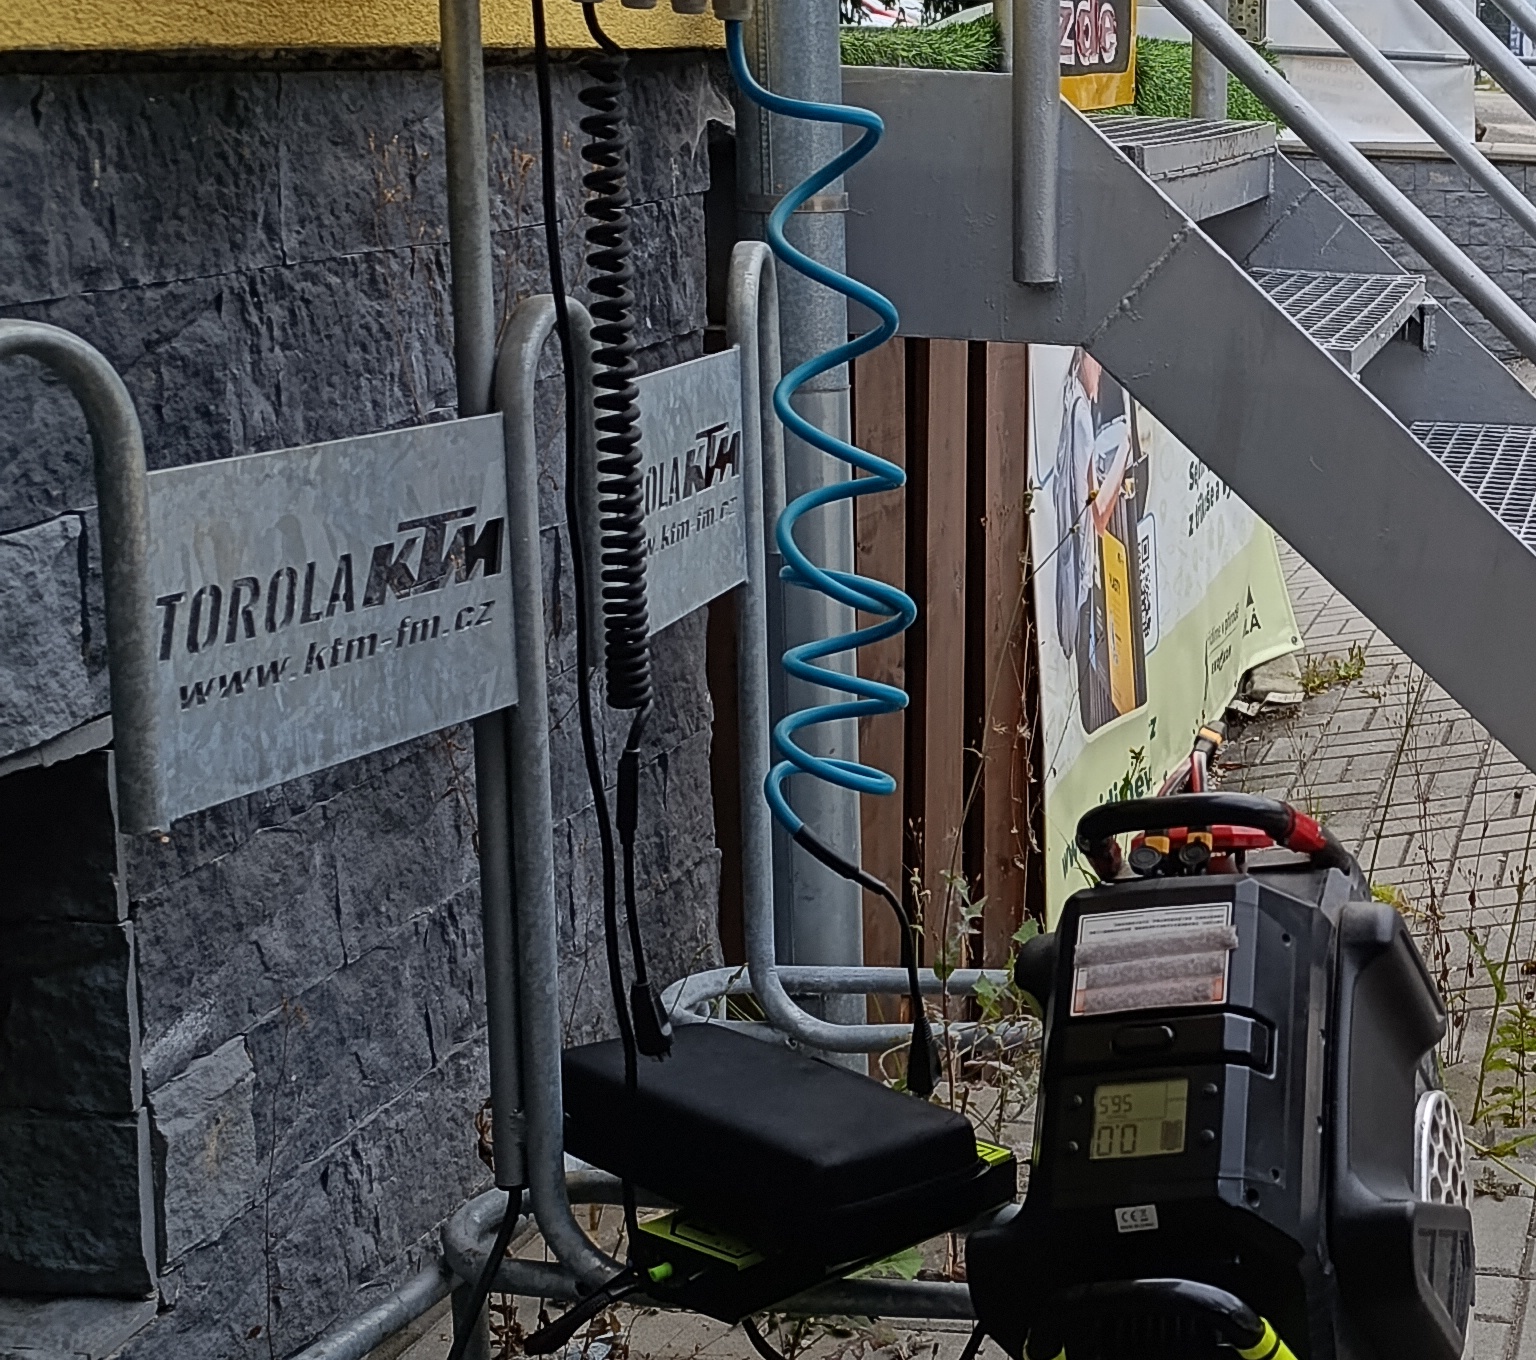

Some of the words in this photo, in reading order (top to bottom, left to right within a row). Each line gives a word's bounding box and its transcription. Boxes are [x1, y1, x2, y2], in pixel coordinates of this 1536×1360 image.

[683, 421, 742, 500] KTM
[155, 552, 355, 663] TOROLA
[362, 505, 505, 609] KTM
[179, 599, 497, 711] www.ktm-fm.cz
